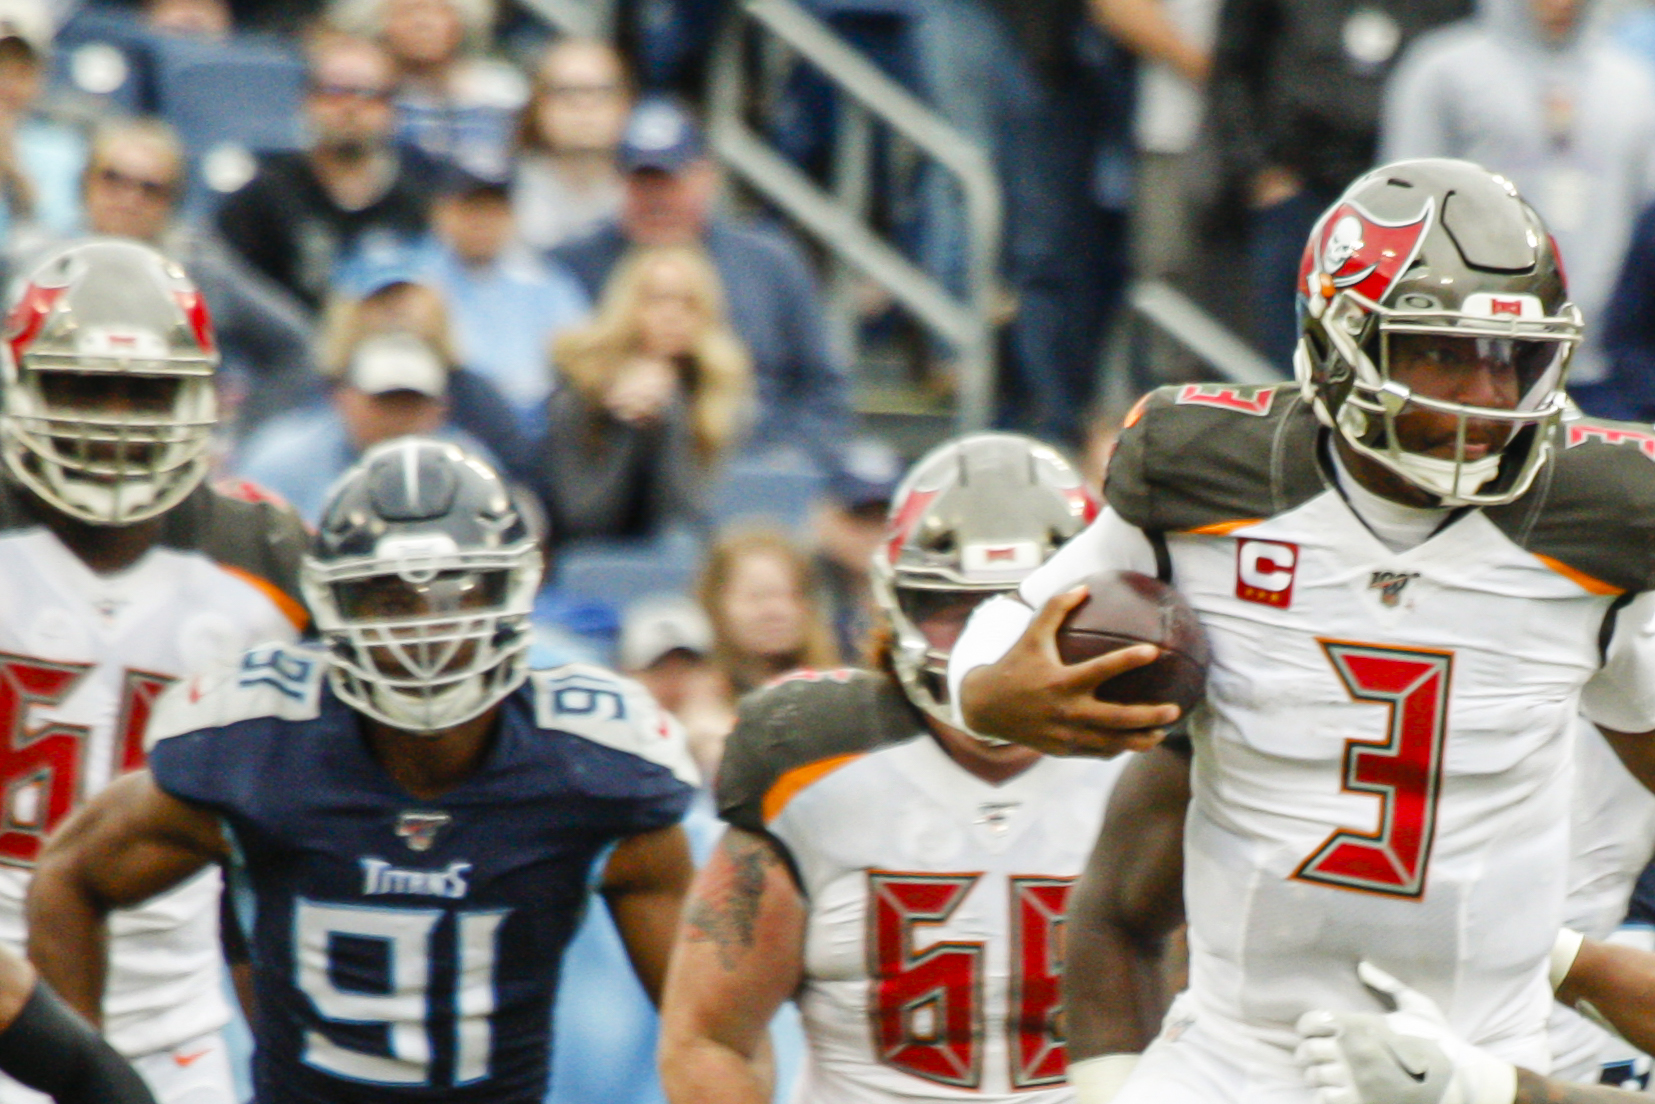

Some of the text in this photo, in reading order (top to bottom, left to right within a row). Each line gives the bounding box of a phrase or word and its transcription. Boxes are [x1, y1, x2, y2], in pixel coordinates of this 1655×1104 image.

[1239, 541, 1294, 591] C
[1287, 636, 1456, 904] 3
[292, 896, 515, 1088] 91
